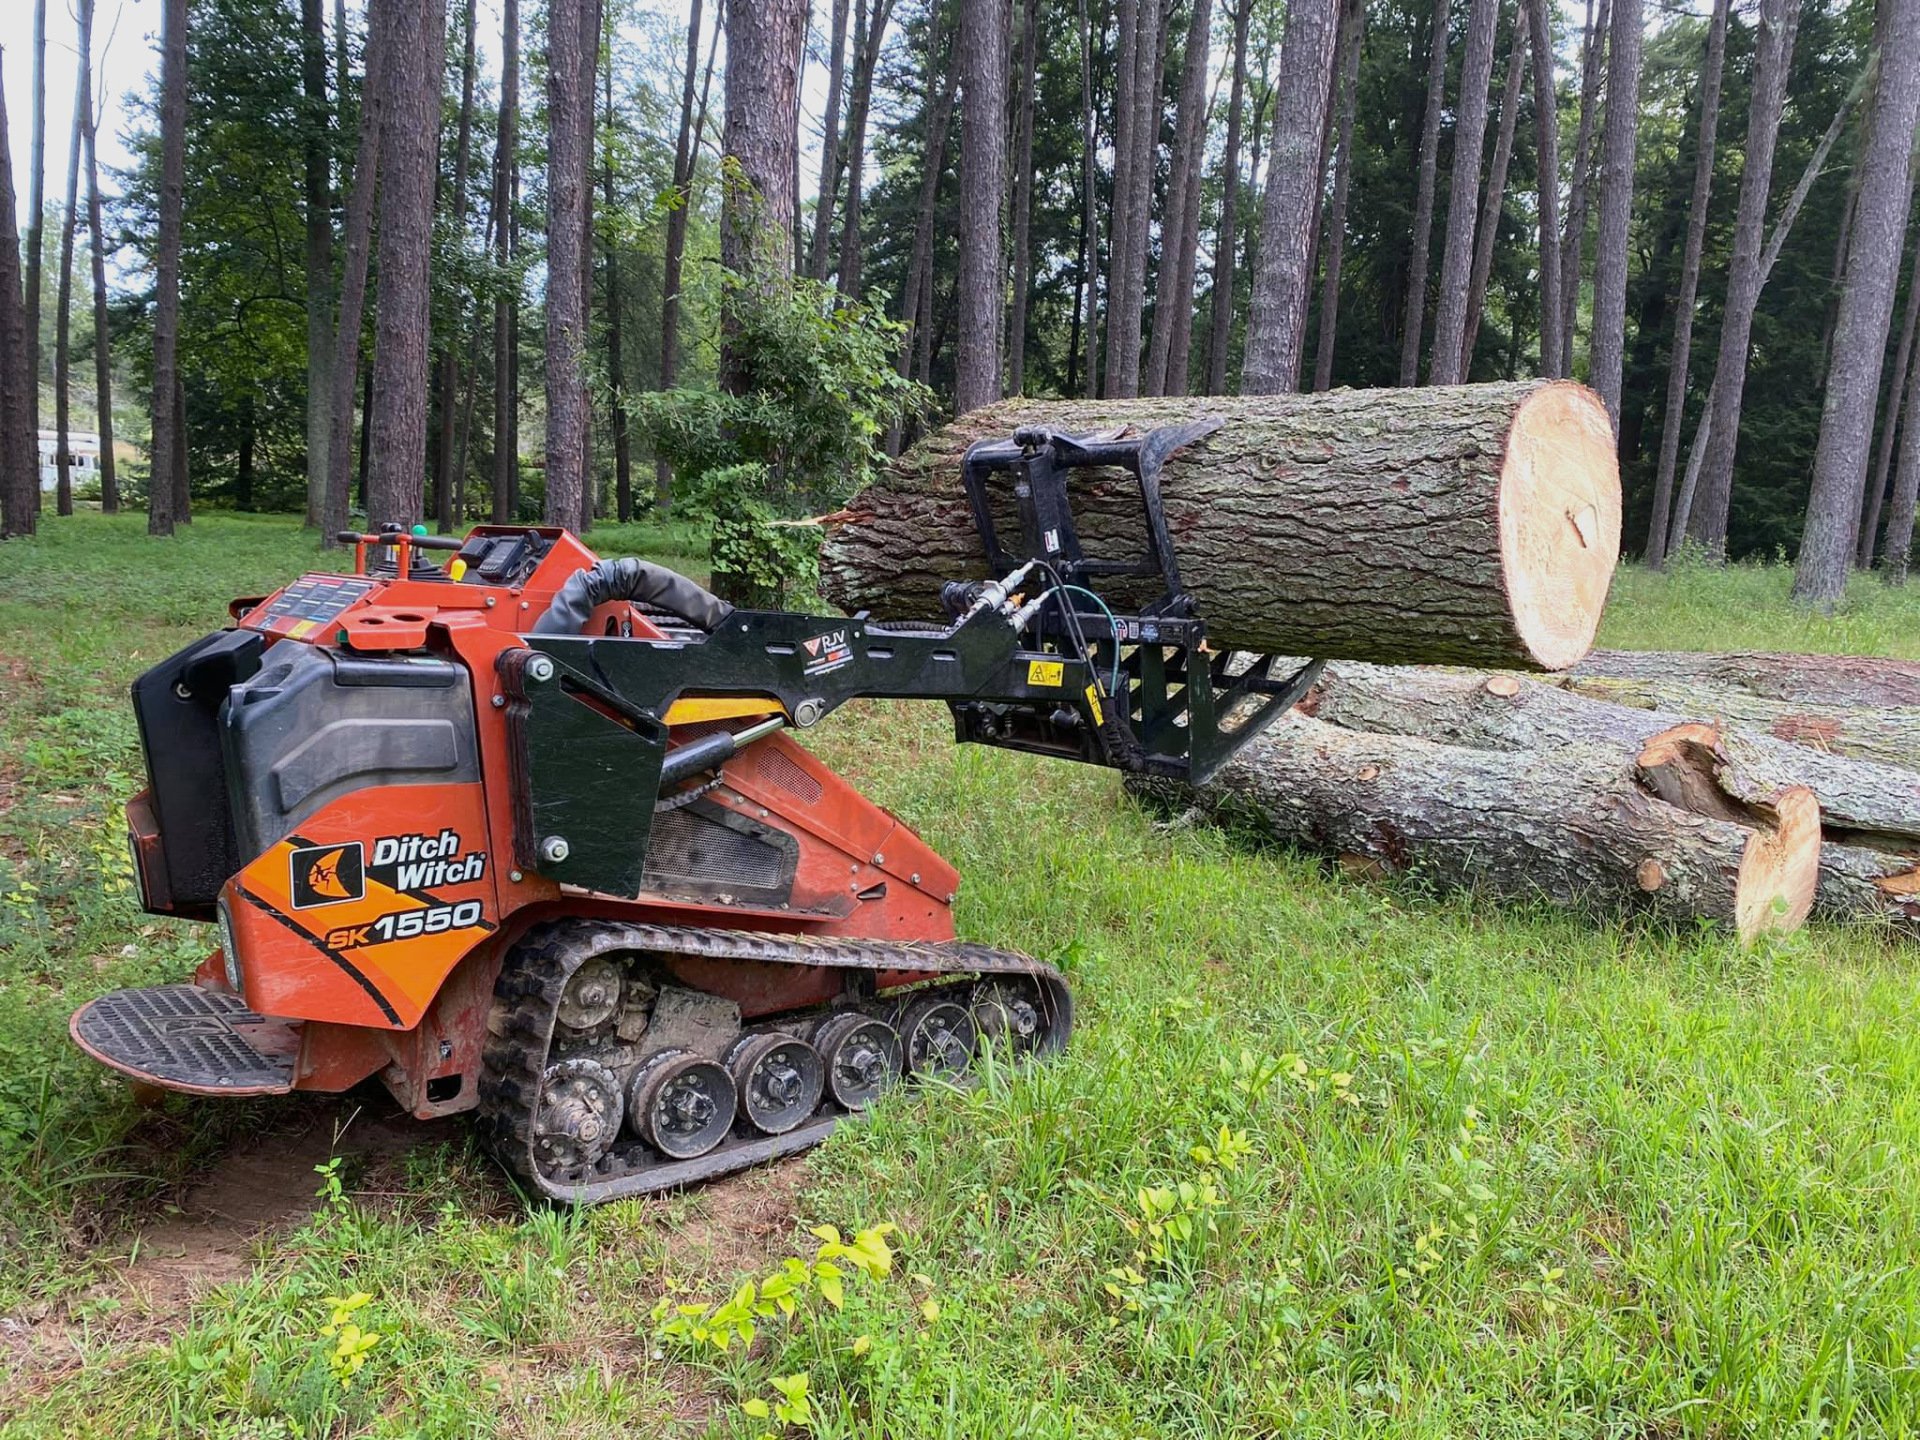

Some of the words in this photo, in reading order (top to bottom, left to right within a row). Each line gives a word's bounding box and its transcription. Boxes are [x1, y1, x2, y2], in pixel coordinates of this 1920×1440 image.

[822, 630, 845, 649] RJV
[373, 831, 458, 866] Ditch
[397, 854, 483, 892] Witch
[328, 928, 369, 949] SK
[374, 902, 480, 940] 1550
